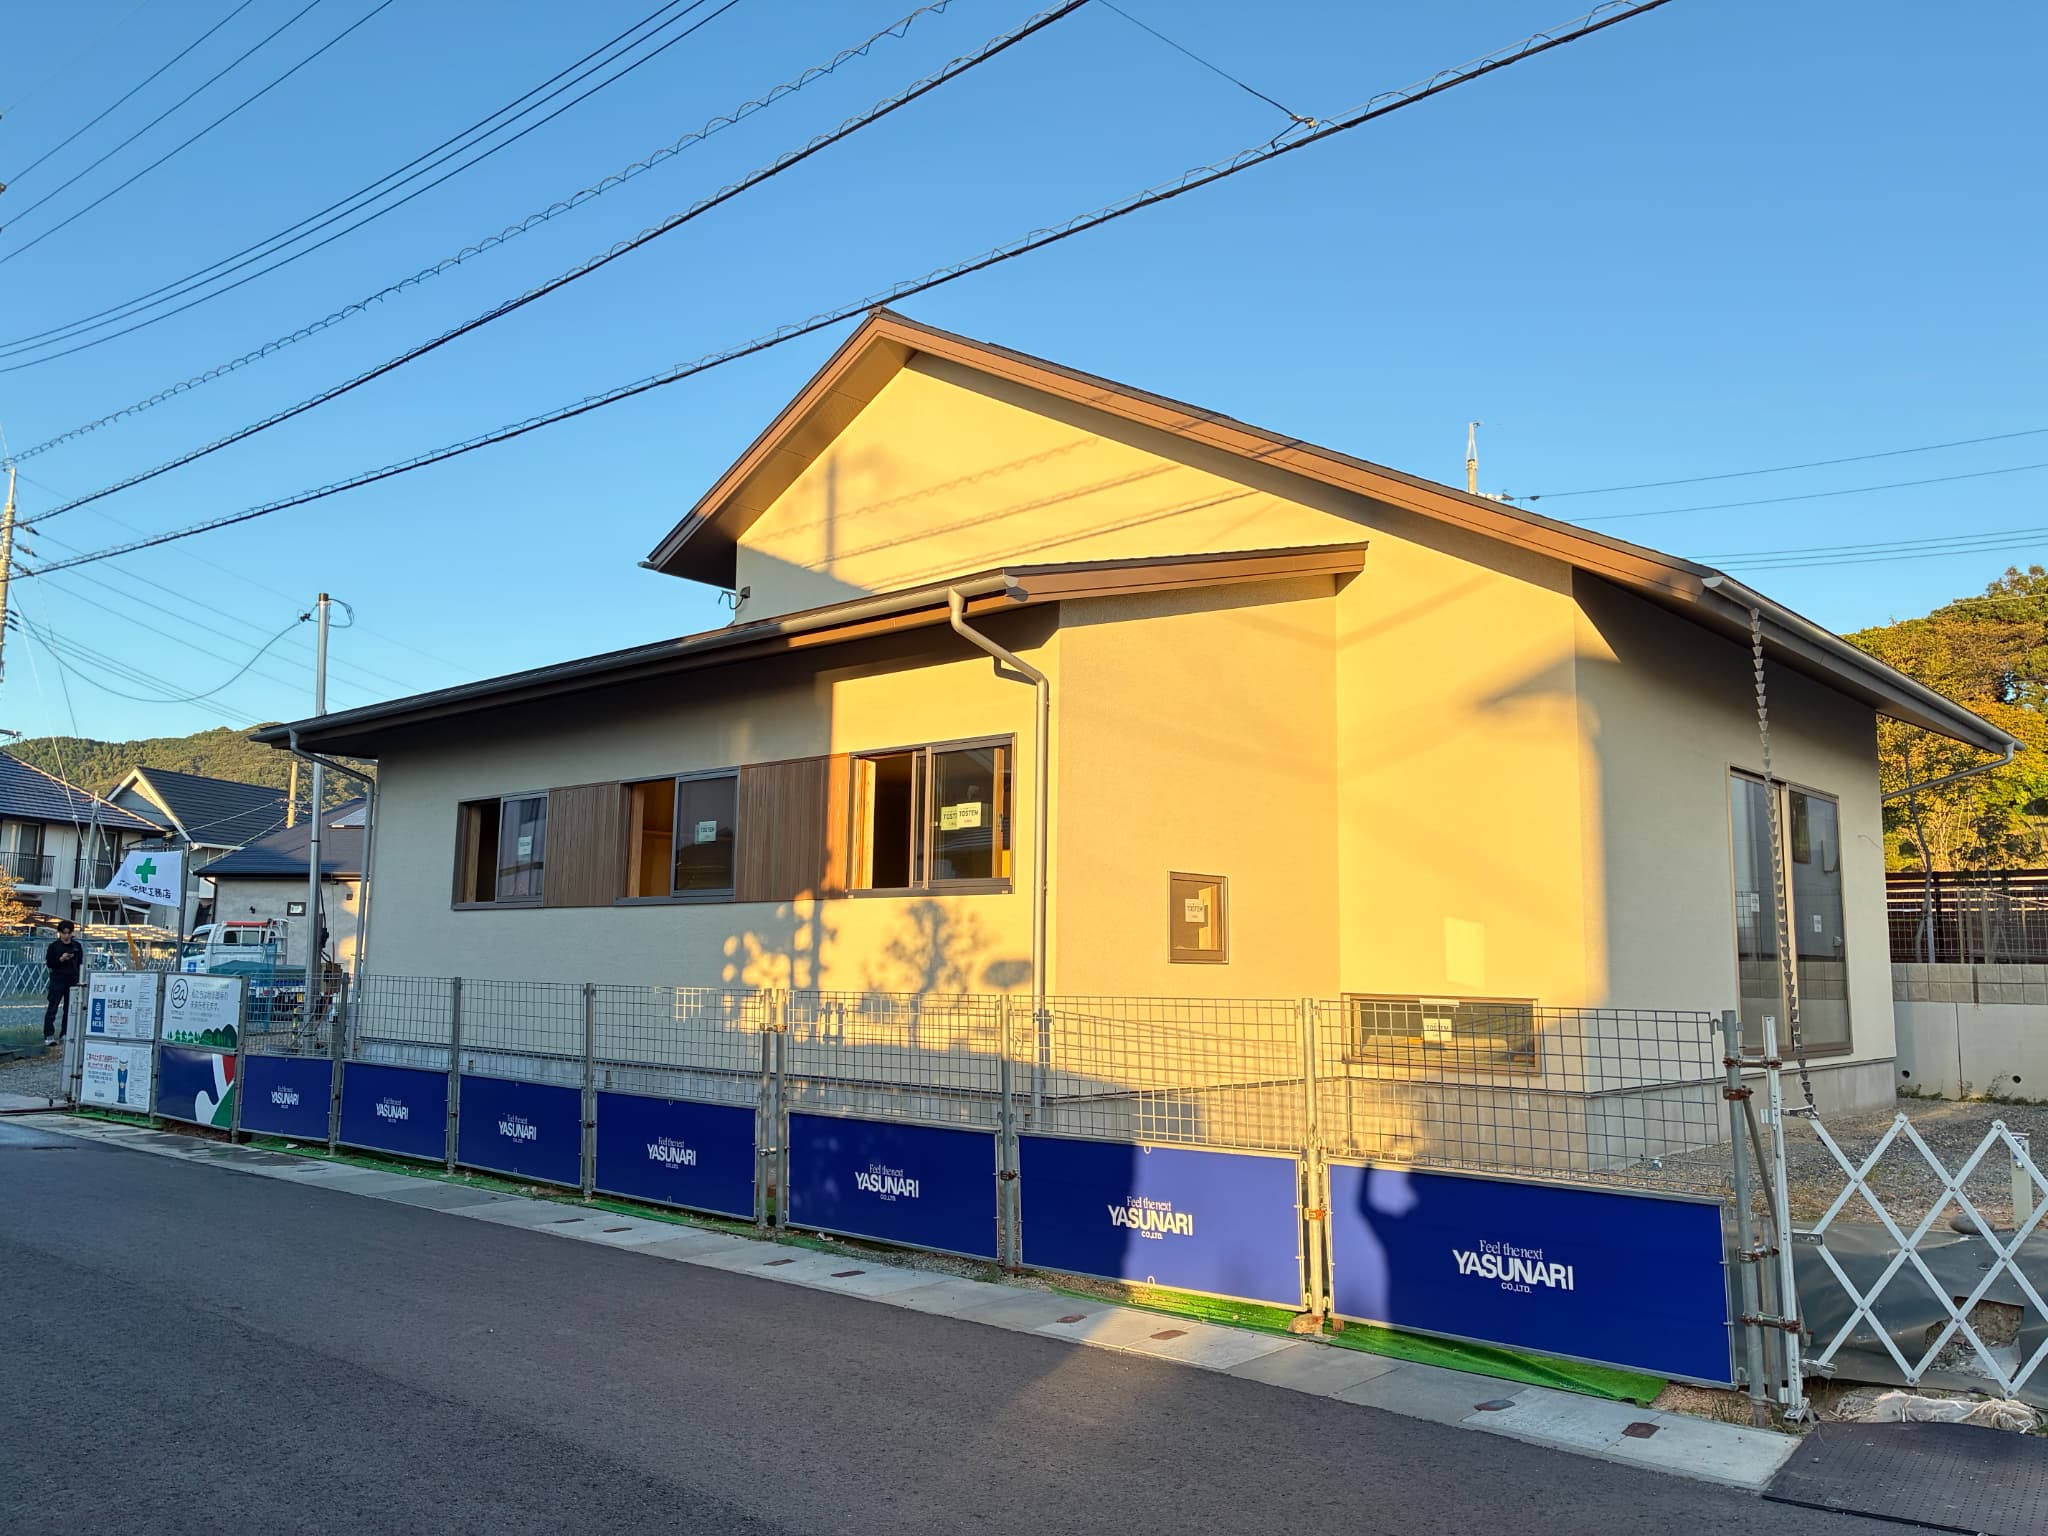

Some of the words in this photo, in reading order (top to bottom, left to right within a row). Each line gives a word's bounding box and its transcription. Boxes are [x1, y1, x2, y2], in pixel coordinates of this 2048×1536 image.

[959, 809, 979, 817] TOSTEM
[376, 1103, 409, 1120] YASUNARI
[498, 1120, 537, 1141] YASUNARI
[647, 1143, 697, 1167] YASUNARI
[854, 1171, 920, 1199] YASUNARI
[1126, 1196, 1142, 1209] Feel
[1143, 1197, 1156, 1210] the
[1156, 1200, 1172, 1211] next
[1107, 1204, 1193, 1237] YASUNARI
[1479, 1239, 1501, 1255] Feel
[1503, 1242, 1521, 1257] the
[1521, 1247, 1544, 1260] next
[1452, 1248, 1574, 1291] YASUNARI
